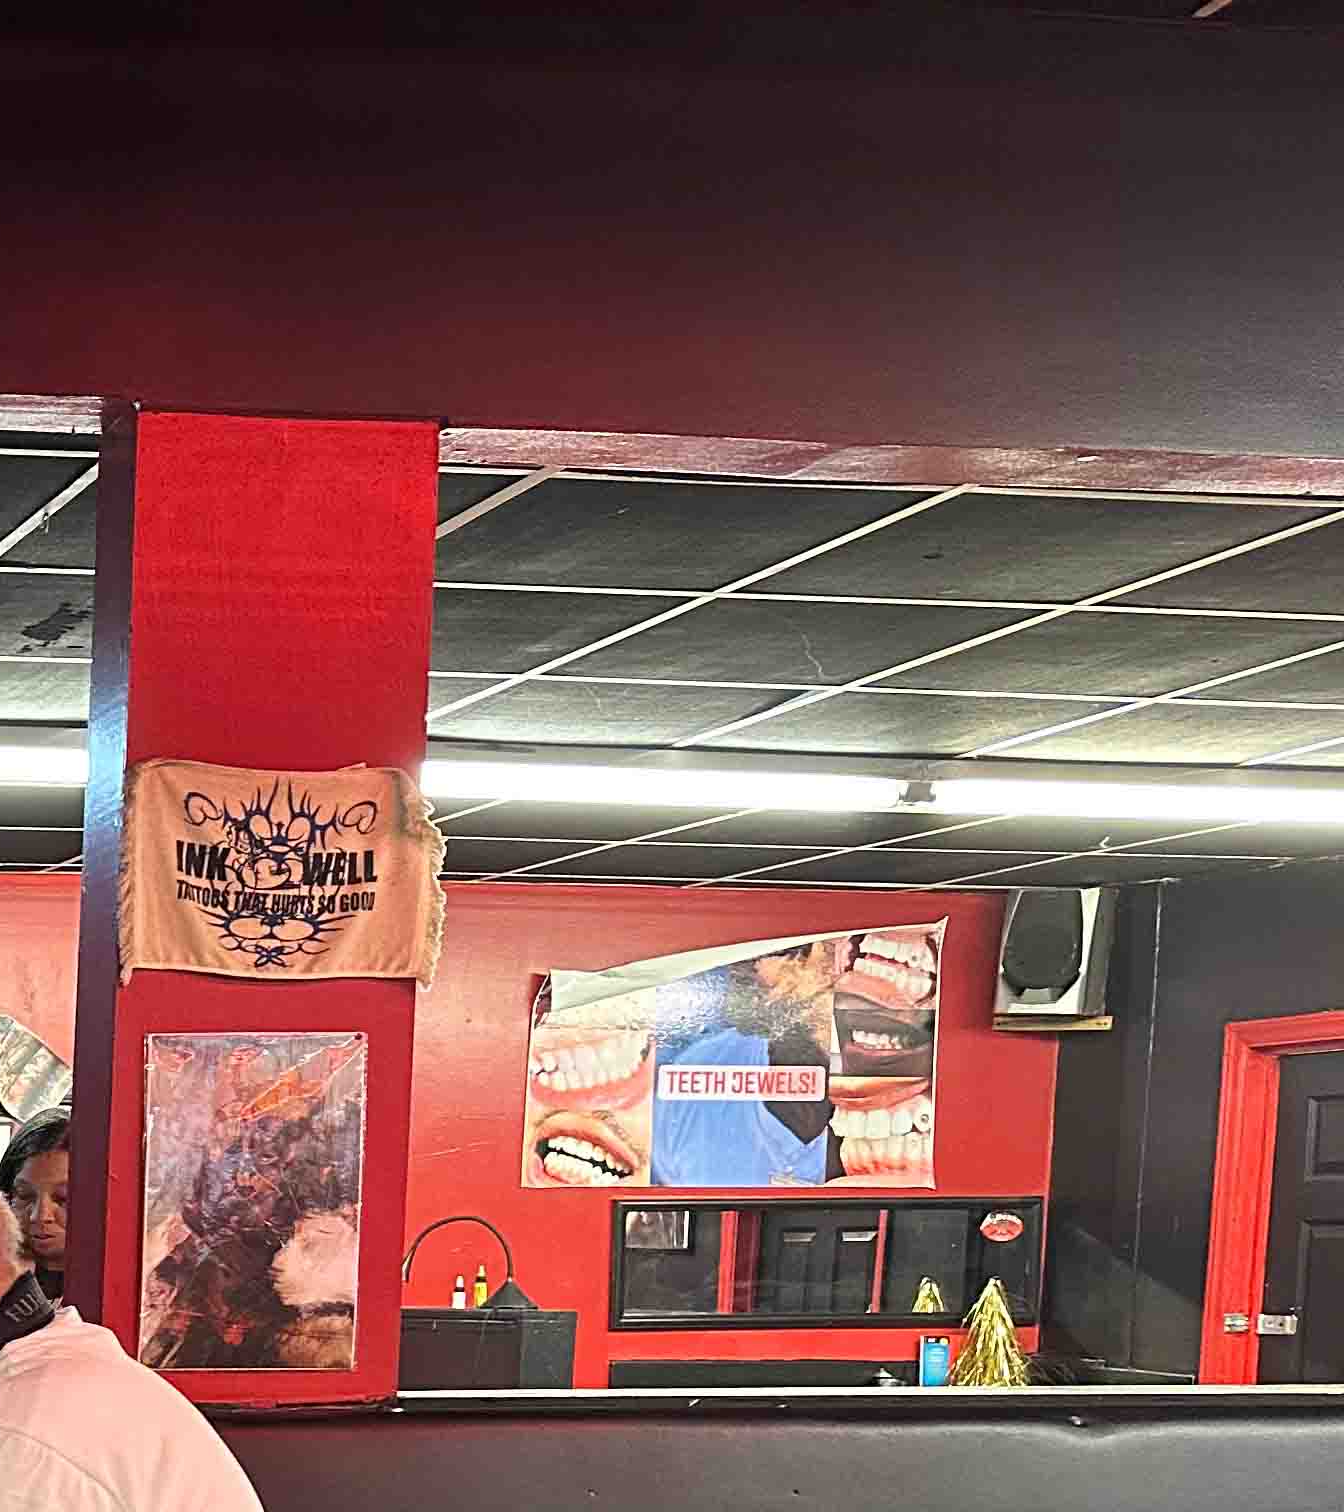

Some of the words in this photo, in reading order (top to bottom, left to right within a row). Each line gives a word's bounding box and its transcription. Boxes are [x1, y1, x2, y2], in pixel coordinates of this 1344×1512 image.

[176, 839, 231, 881] INK
[303, 850, 377, 886] WELL
[176, 879, 229, 909] TATTOOS
[233, 889, 270, 912] THAT
[271, 893, 314, 913] HURTS
[317, 894, 336, 914] SO
[340, 891, 375, 912] GOOD
[667, 1071, 726, 1094] TEETH
[731, 1071, 817, 1094] JEWELS!
